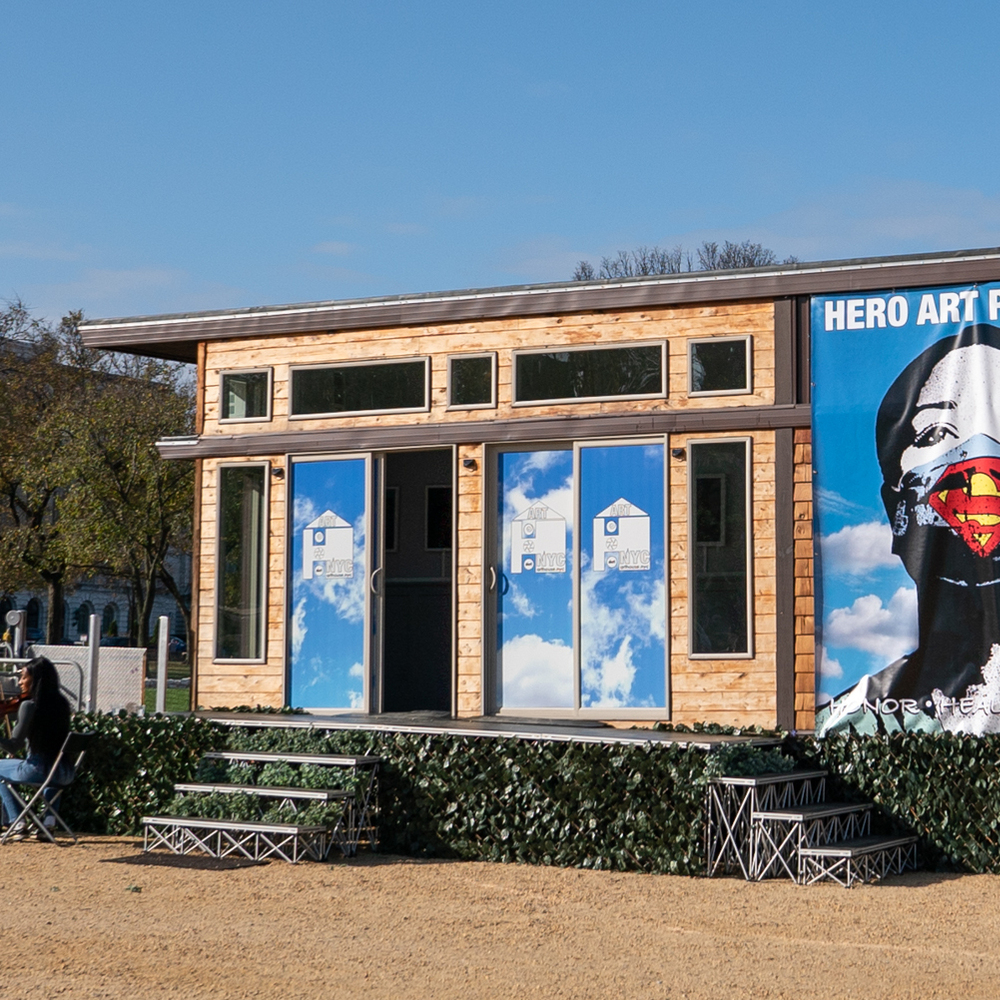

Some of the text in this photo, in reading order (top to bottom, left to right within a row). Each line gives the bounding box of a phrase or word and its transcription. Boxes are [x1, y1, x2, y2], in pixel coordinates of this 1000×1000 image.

[824, 295, 909, 332] HERO
[916, 290, 979, 326] ART
[527, 507, 549, 519] ART
[608, 504, 632, 517] ART
[318, 516, 337, 527] ART
[536, 550, 566, 567] NYC
[619, 548, 650, 564] NYC
[325, 557, 353, 573] NYC
[830, 698, 919, 715] HONOR
